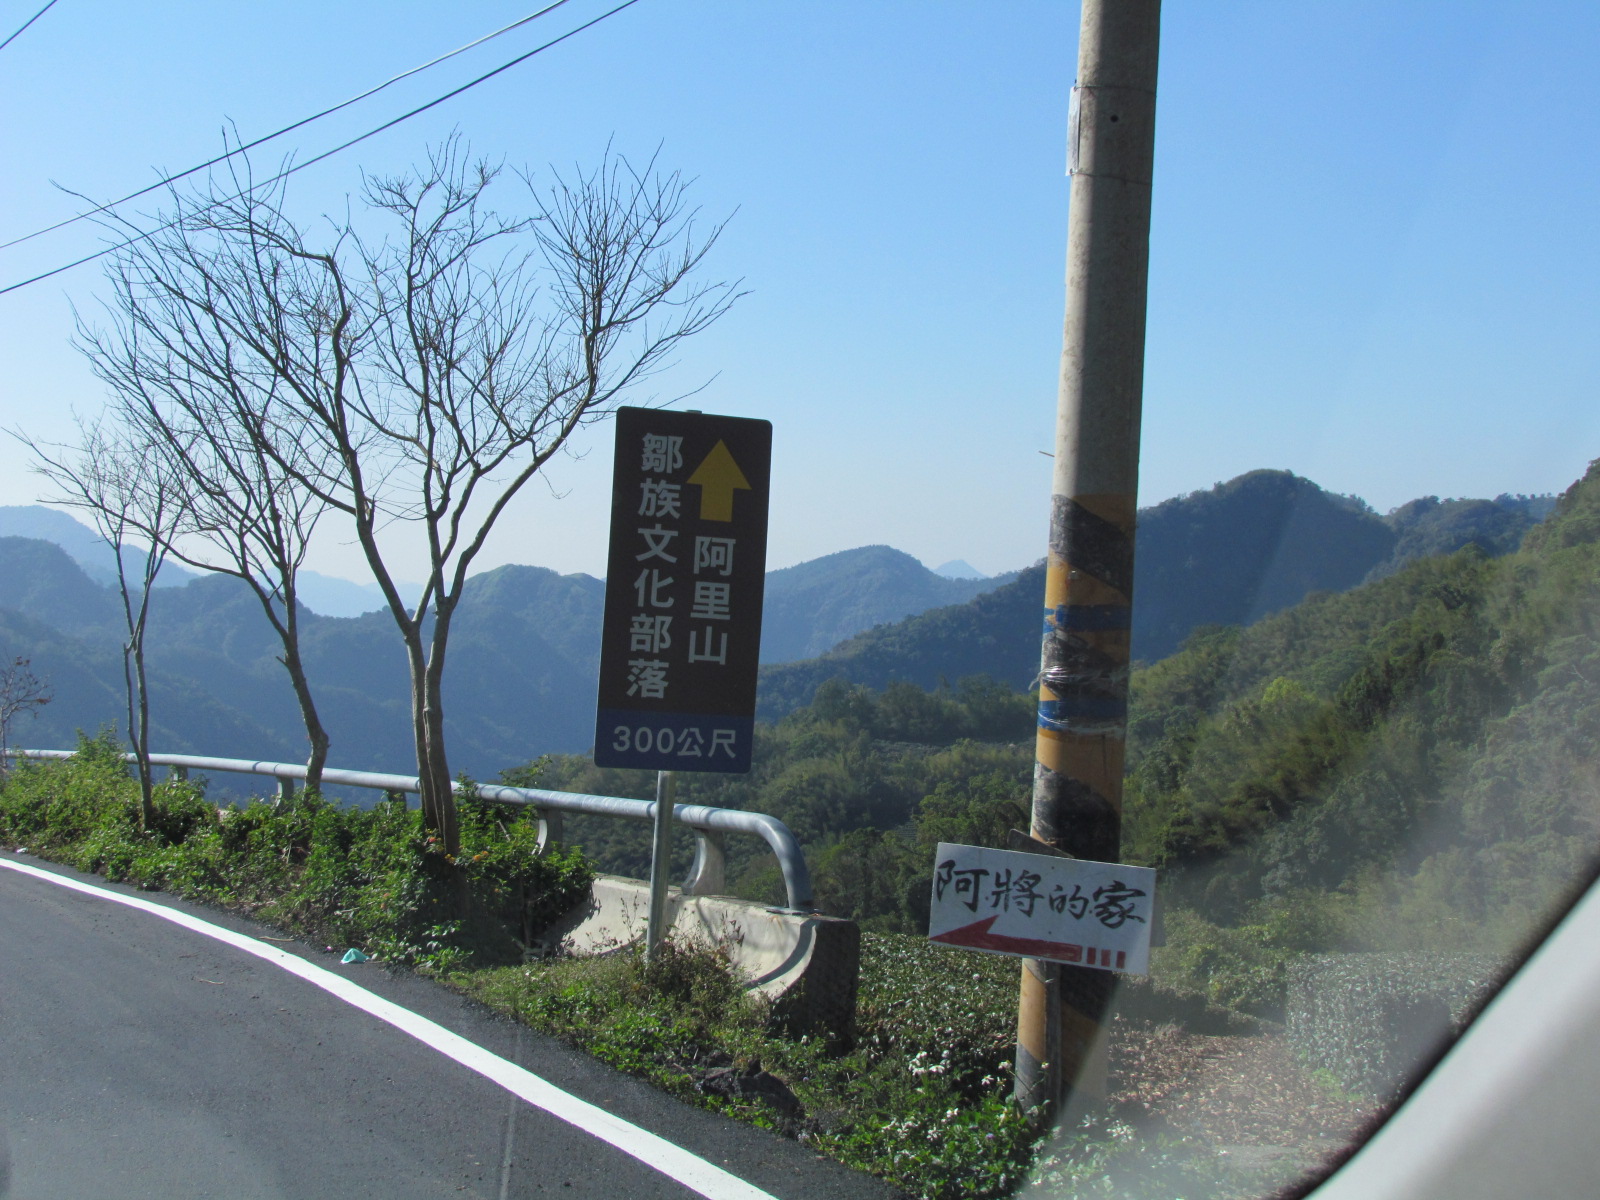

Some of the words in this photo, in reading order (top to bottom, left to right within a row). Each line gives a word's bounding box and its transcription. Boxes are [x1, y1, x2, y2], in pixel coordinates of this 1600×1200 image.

[626, 432, 684, 699] 鄒族文化部落
[688, 535, 737, 665] 阿里山
[612, 725, 737, 759] 300公尺
[936, 859, 1146, 929] 阿將的家
